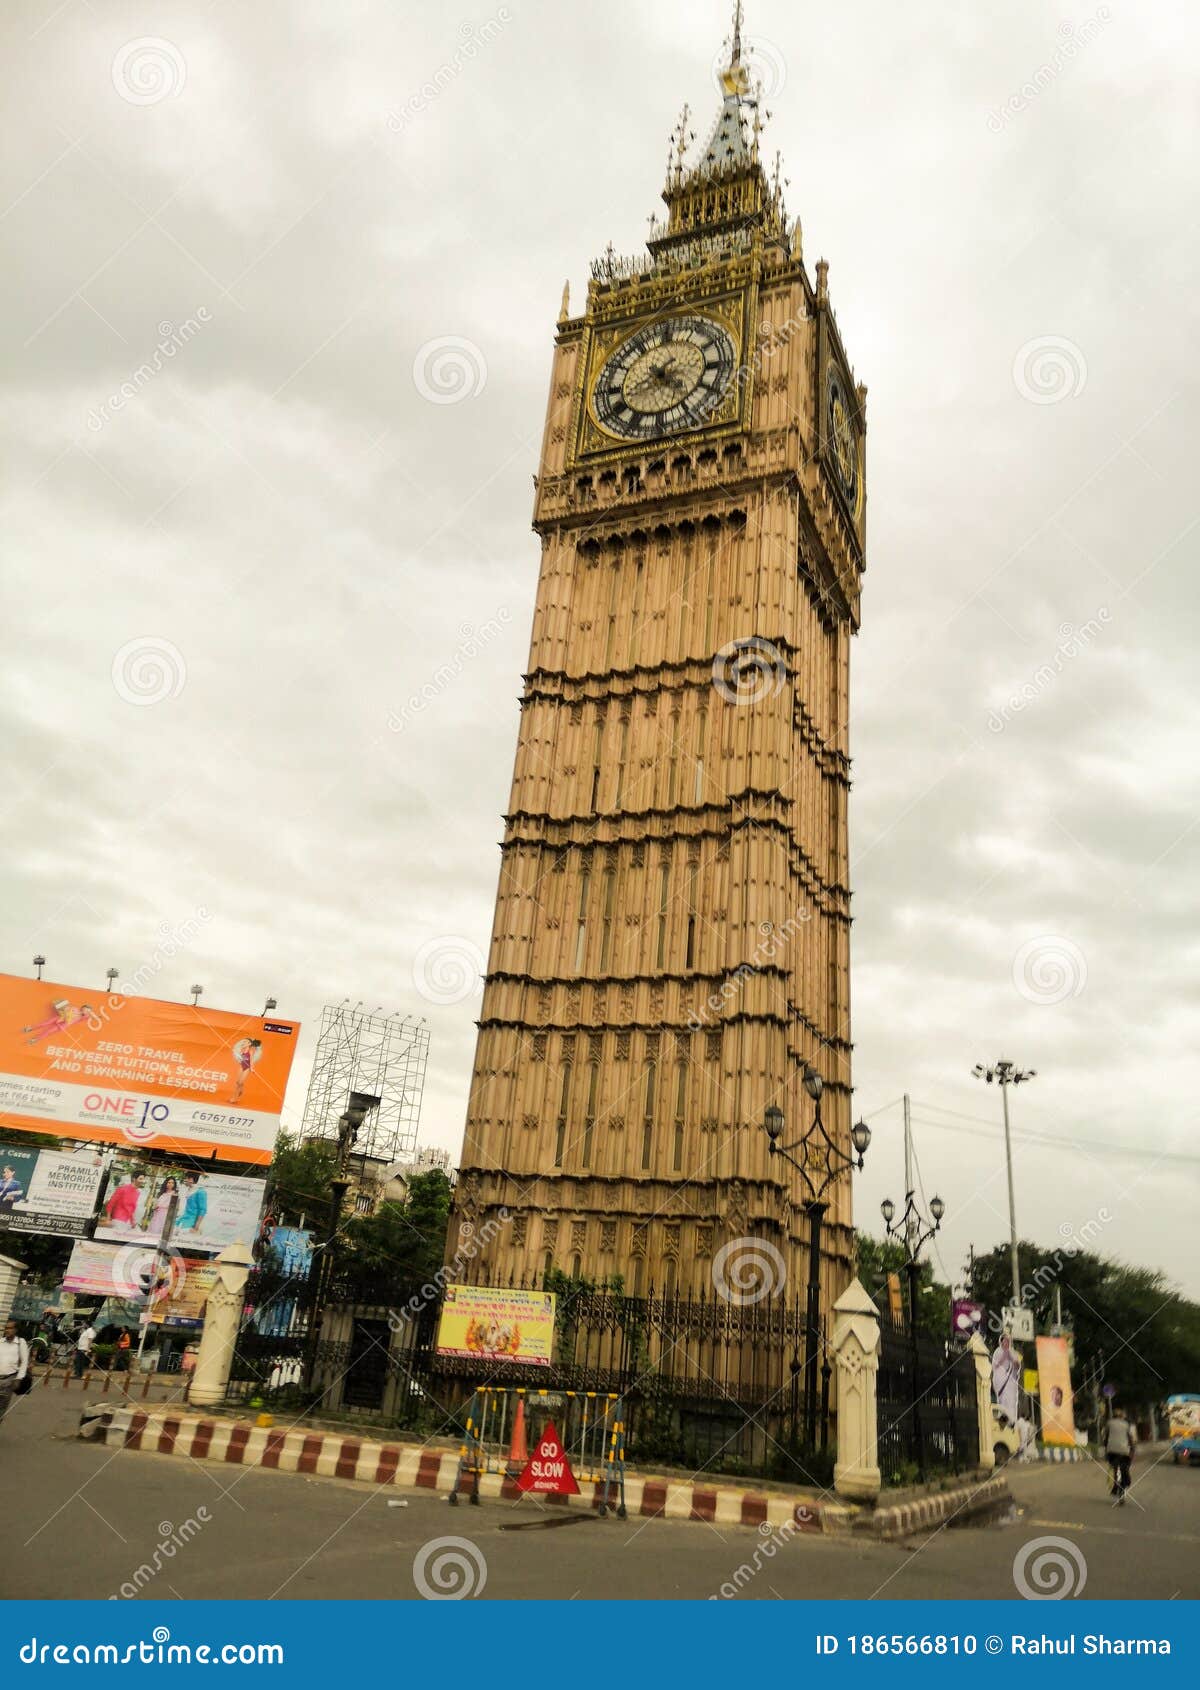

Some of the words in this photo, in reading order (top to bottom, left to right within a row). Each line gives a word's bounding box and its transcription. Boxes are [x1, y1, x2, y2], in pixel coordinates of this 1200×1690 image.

[97, 1040, 134, 1055] ZERO
[137, 1045, 186, 1064] TRAVEL
[46, 1045, 114, 1064] BETWEEN
[116, 1056, 172, 1074] TUITION,
[175, 1065, 229, 1082] SOCCER
[50, 1060, 81, 1073] AND
[84, 1064, 155, 1084] SWIMMING
[158, 1075, 217, 1093] LESSONS
[83, 1093, 138, 1116] ONE
[199, 1112, 225, 1123] 6767
[228, 1116, 254, 1127] 6777
[48, 1171, 98, 1185] MEMORIAL
[58, 1164, 99, 1177] PRAMILA
[47, 1181, 97, 1193] INSTITUTE
[540, 1442, 558, 1458] GO
[531, 1461, 565, 1478] SLOW
